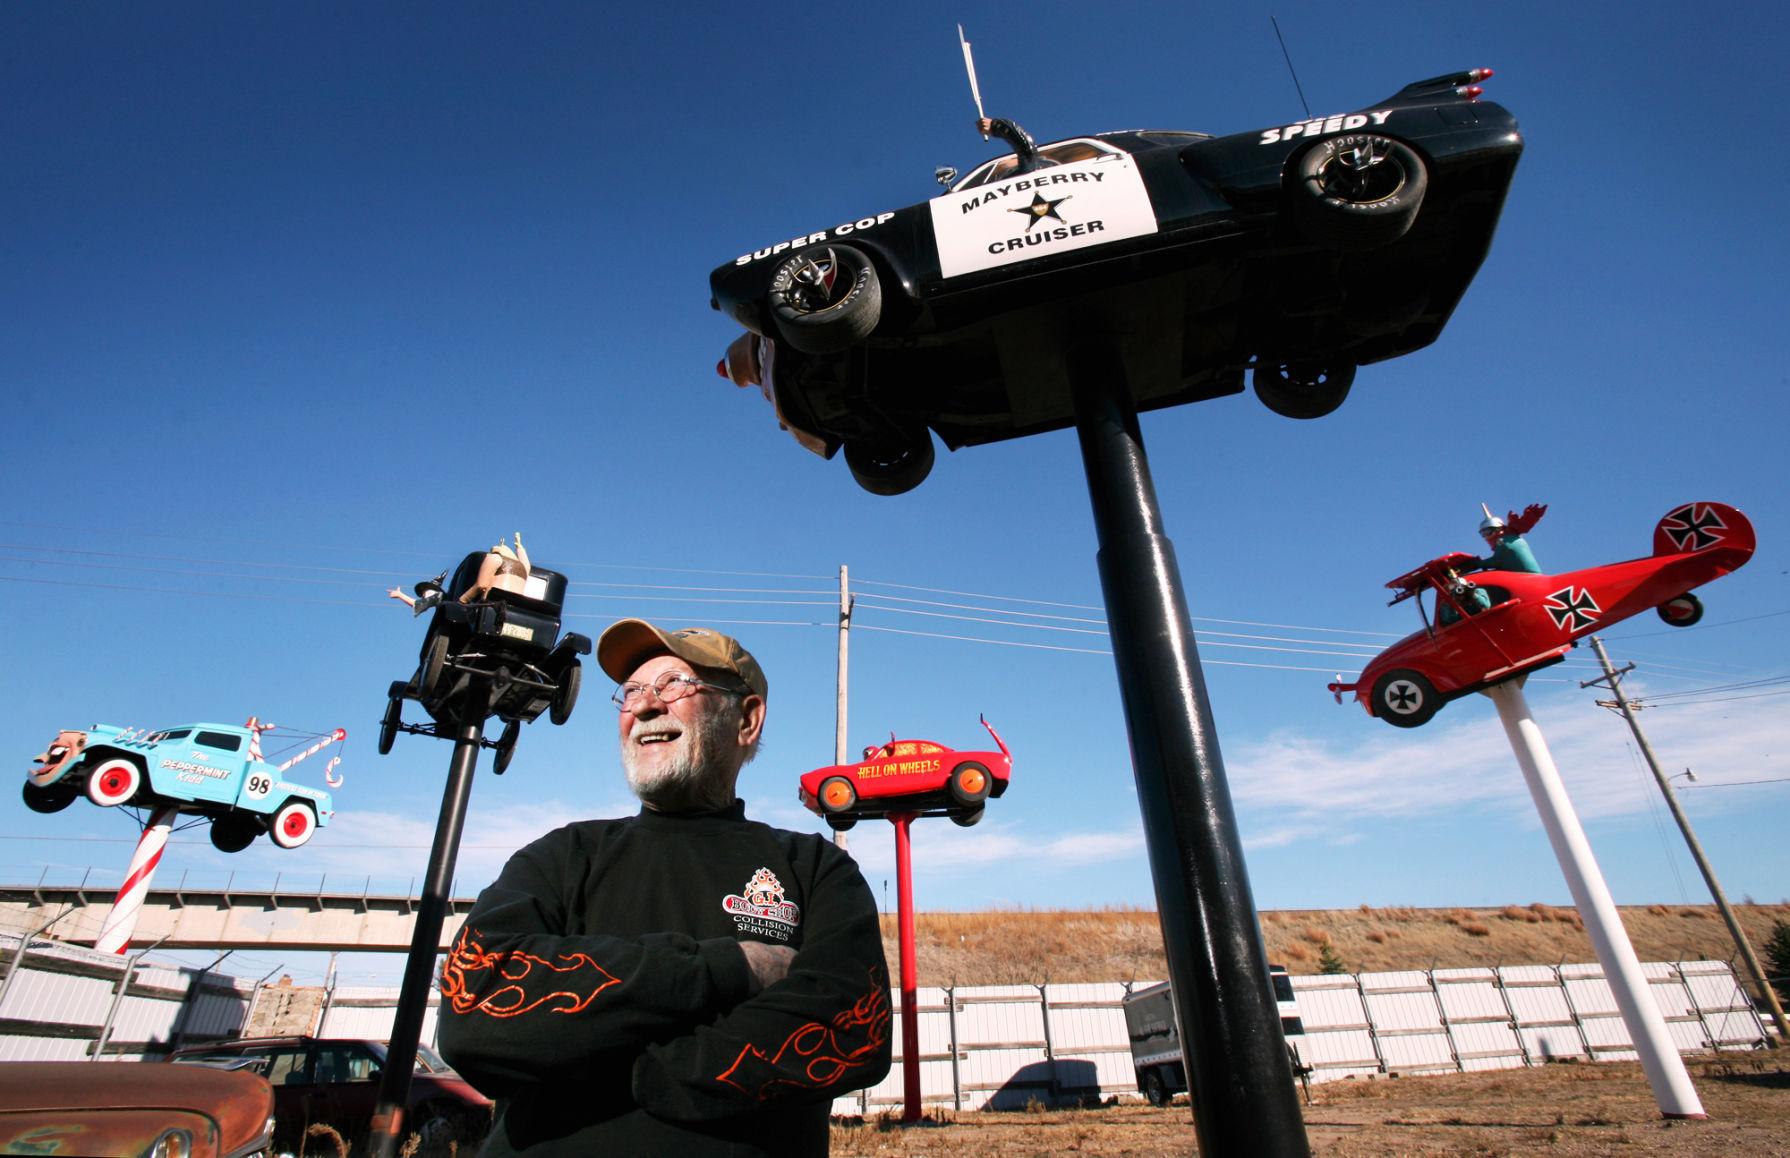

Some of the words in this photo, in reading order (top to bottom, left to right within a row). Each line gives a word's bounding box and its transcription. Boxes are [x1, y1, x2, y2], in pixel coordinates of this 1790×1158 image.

[1259, 110, 1392, 145] SPEEDY
[961, 172, 1104, 214] MAYBERRY
[736, 231, 827, 266] SUPER
[835, 212, 895, 235] COP
[988, 220, 1105, 254] CRUISER
[160, 759, 231, 780] PEPPERMINT
[857, 766, 882, 780] HELL
[883, 763, 897, 776] ON
[899, 760, 940, 775] WHEELS
[248, 776, 270, 794] 98
[752, 891, 778, 906] G.I.
[733, 915, 794, 935] COLLISION
[737, 922, 789, 942] SERVICES
